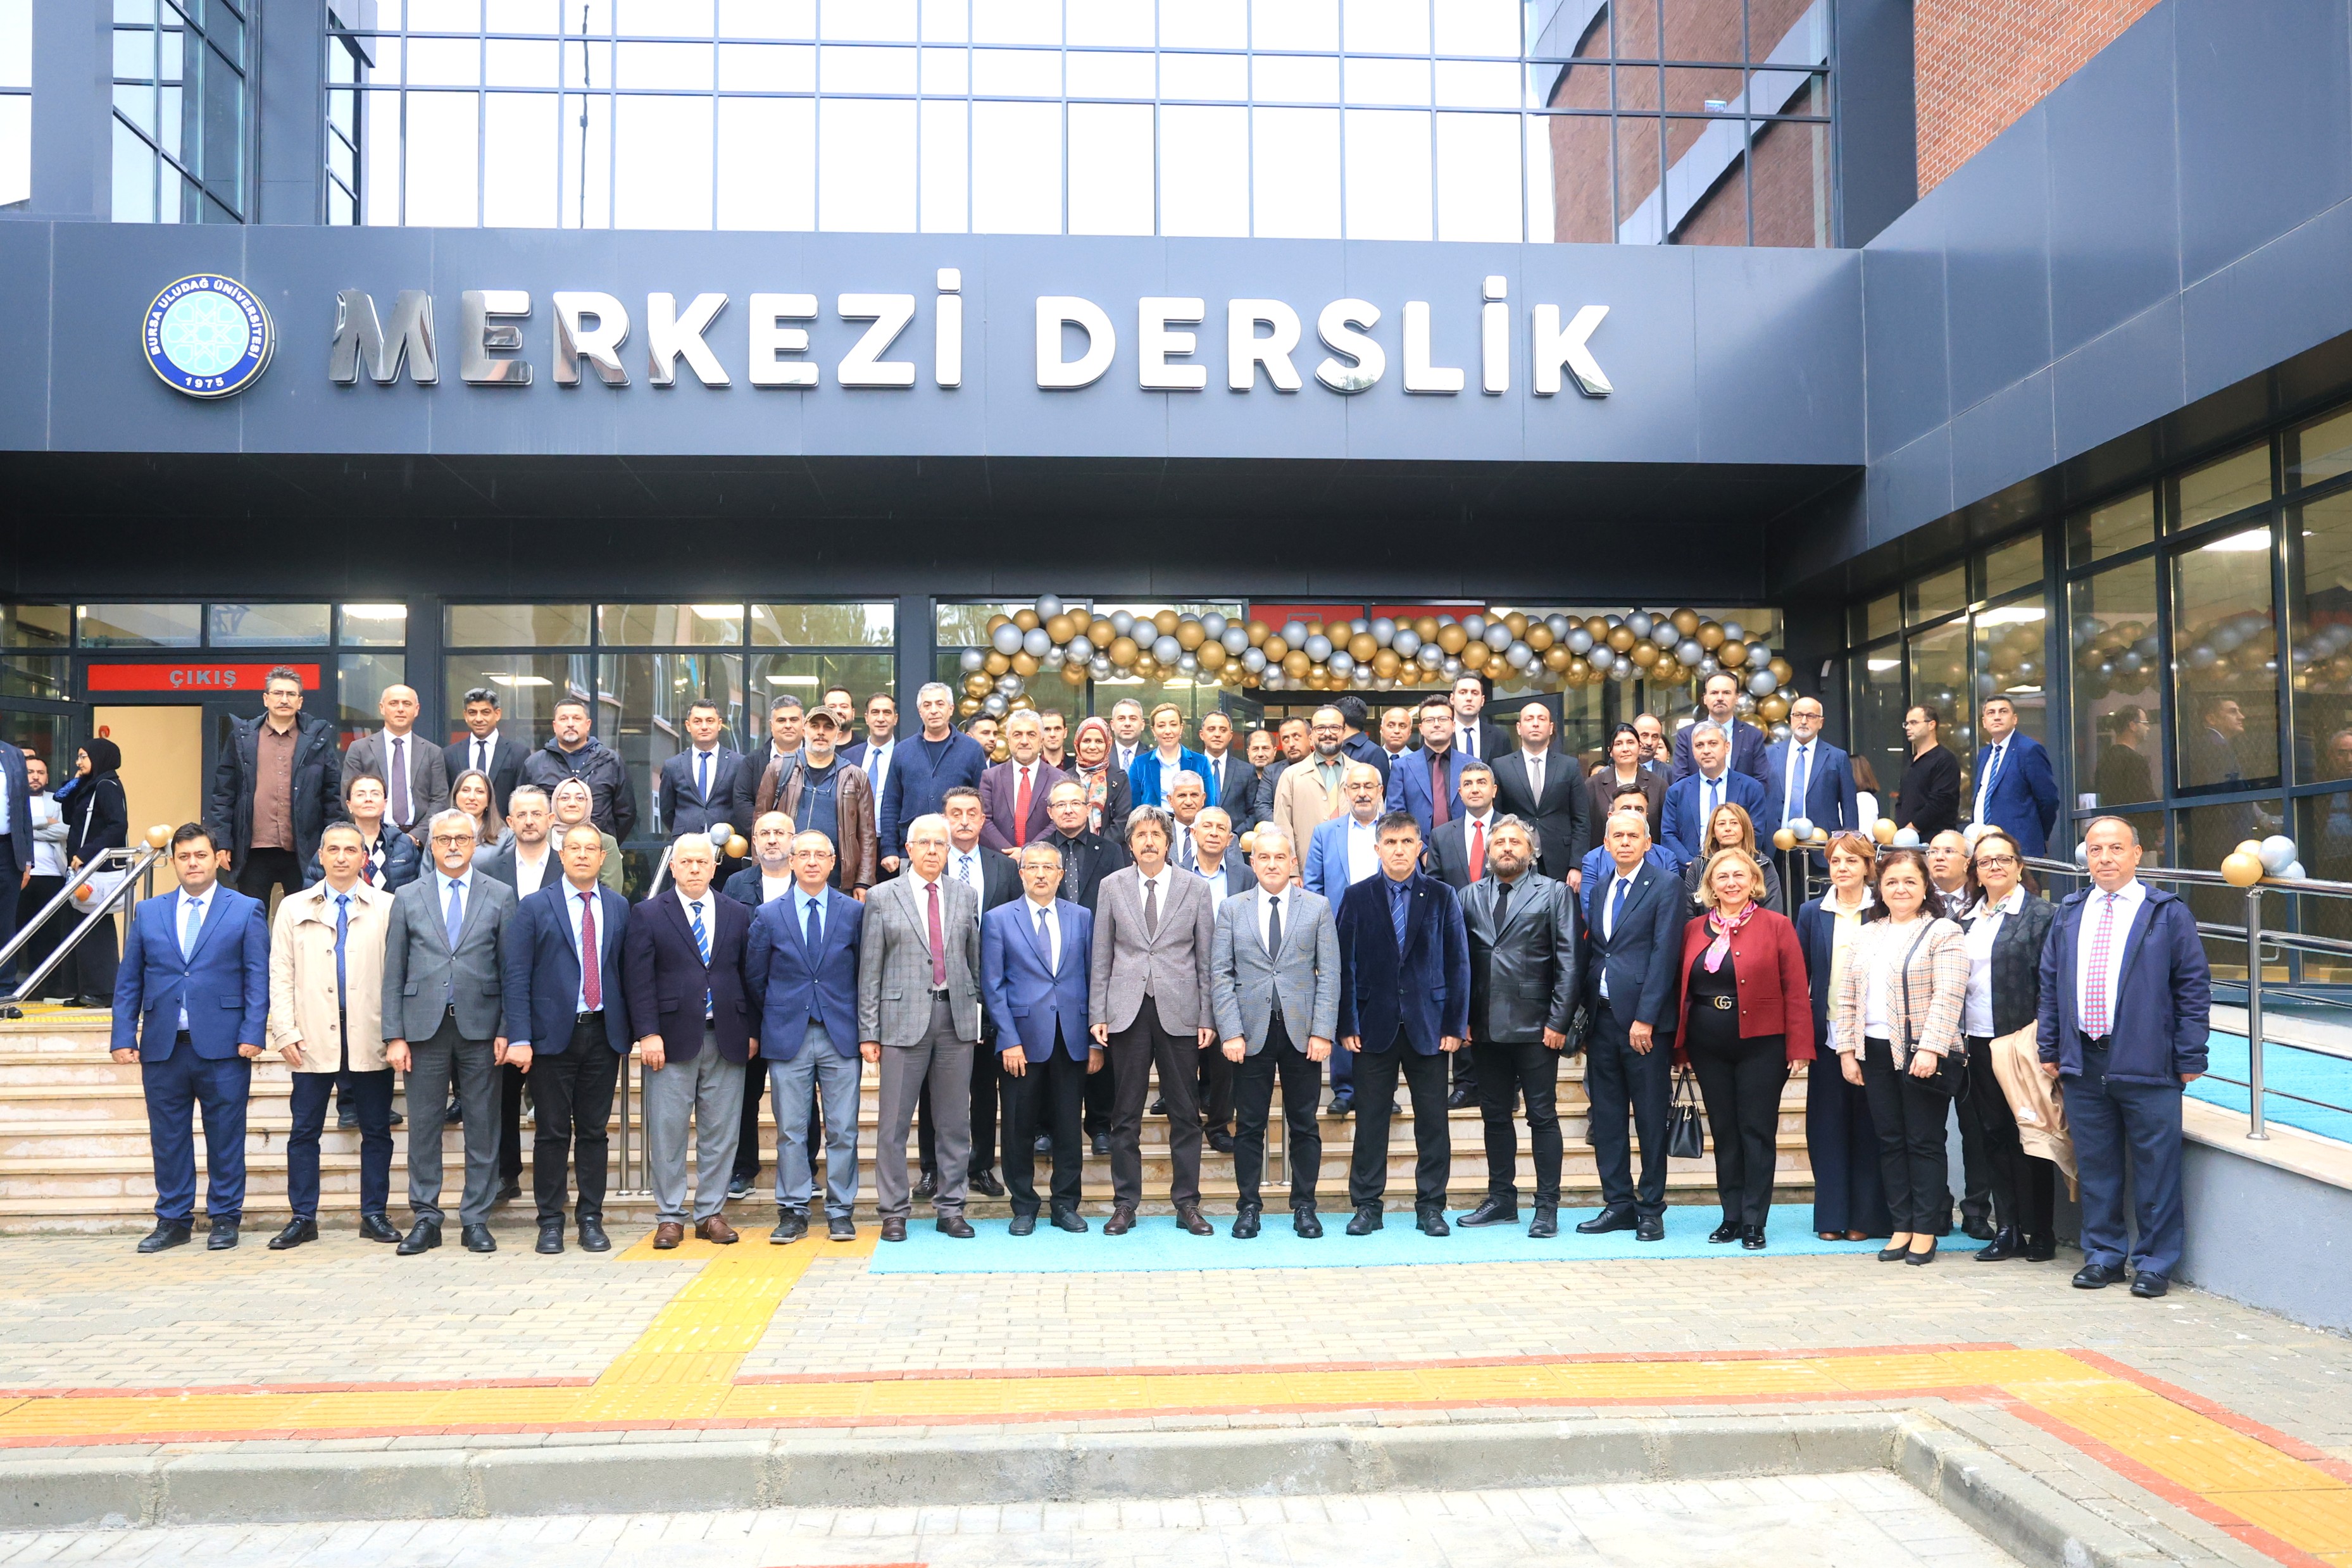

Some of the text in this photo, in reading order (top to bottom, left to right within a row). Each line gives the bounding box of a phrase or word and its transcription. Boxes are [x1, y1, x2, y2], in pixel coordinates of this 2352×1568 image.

[148, 312, 162, 356] BURSA
[158, 277, 209, 309] ULUDAĞ
[328, 268, 1614, 397] MERKEZİ DERSLİK
[185, 377, 224, 389] 1975
[169, 669, 237, 688] ÇIKIŞ
